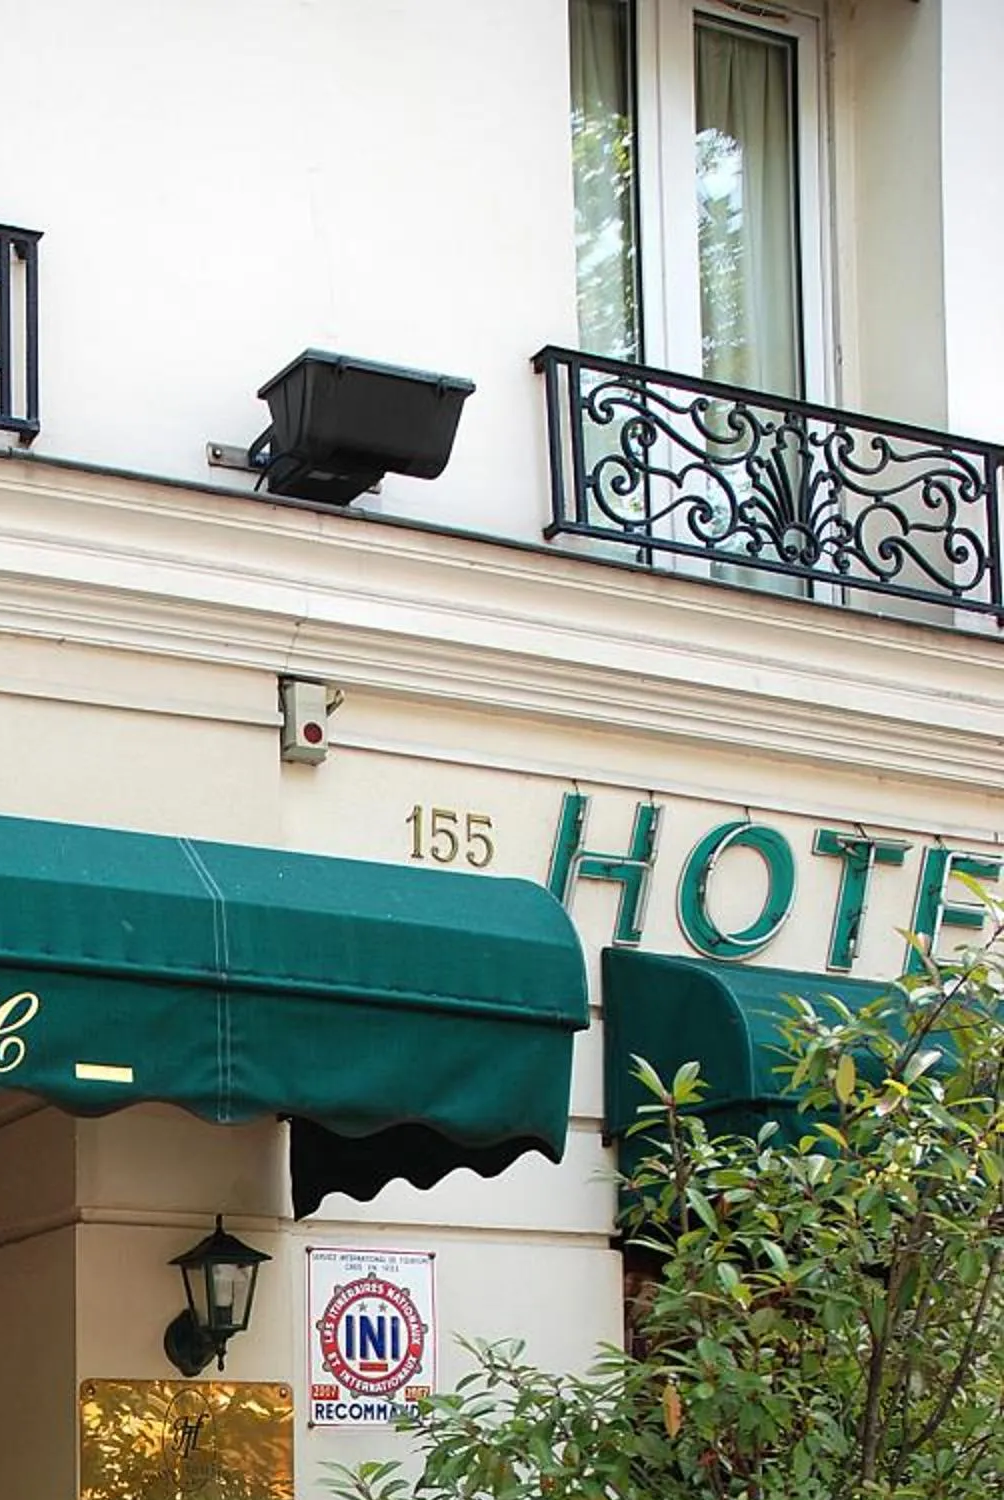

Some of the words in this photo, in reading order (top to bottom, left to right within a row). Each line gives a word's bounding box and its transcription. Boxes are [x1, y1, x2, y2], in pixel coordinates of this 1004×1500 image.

[405, 804, 495, 868] 155
[324, 1322, 335, 1343] LES
[330, 1283, 384, 1319] ITINERAIRES
[386, 1288, 422, 1345] NATIONAUX
[344, 1314, 400, 1360] INI
[339, 1354, 417, 1393] INTERNATIONAUX
